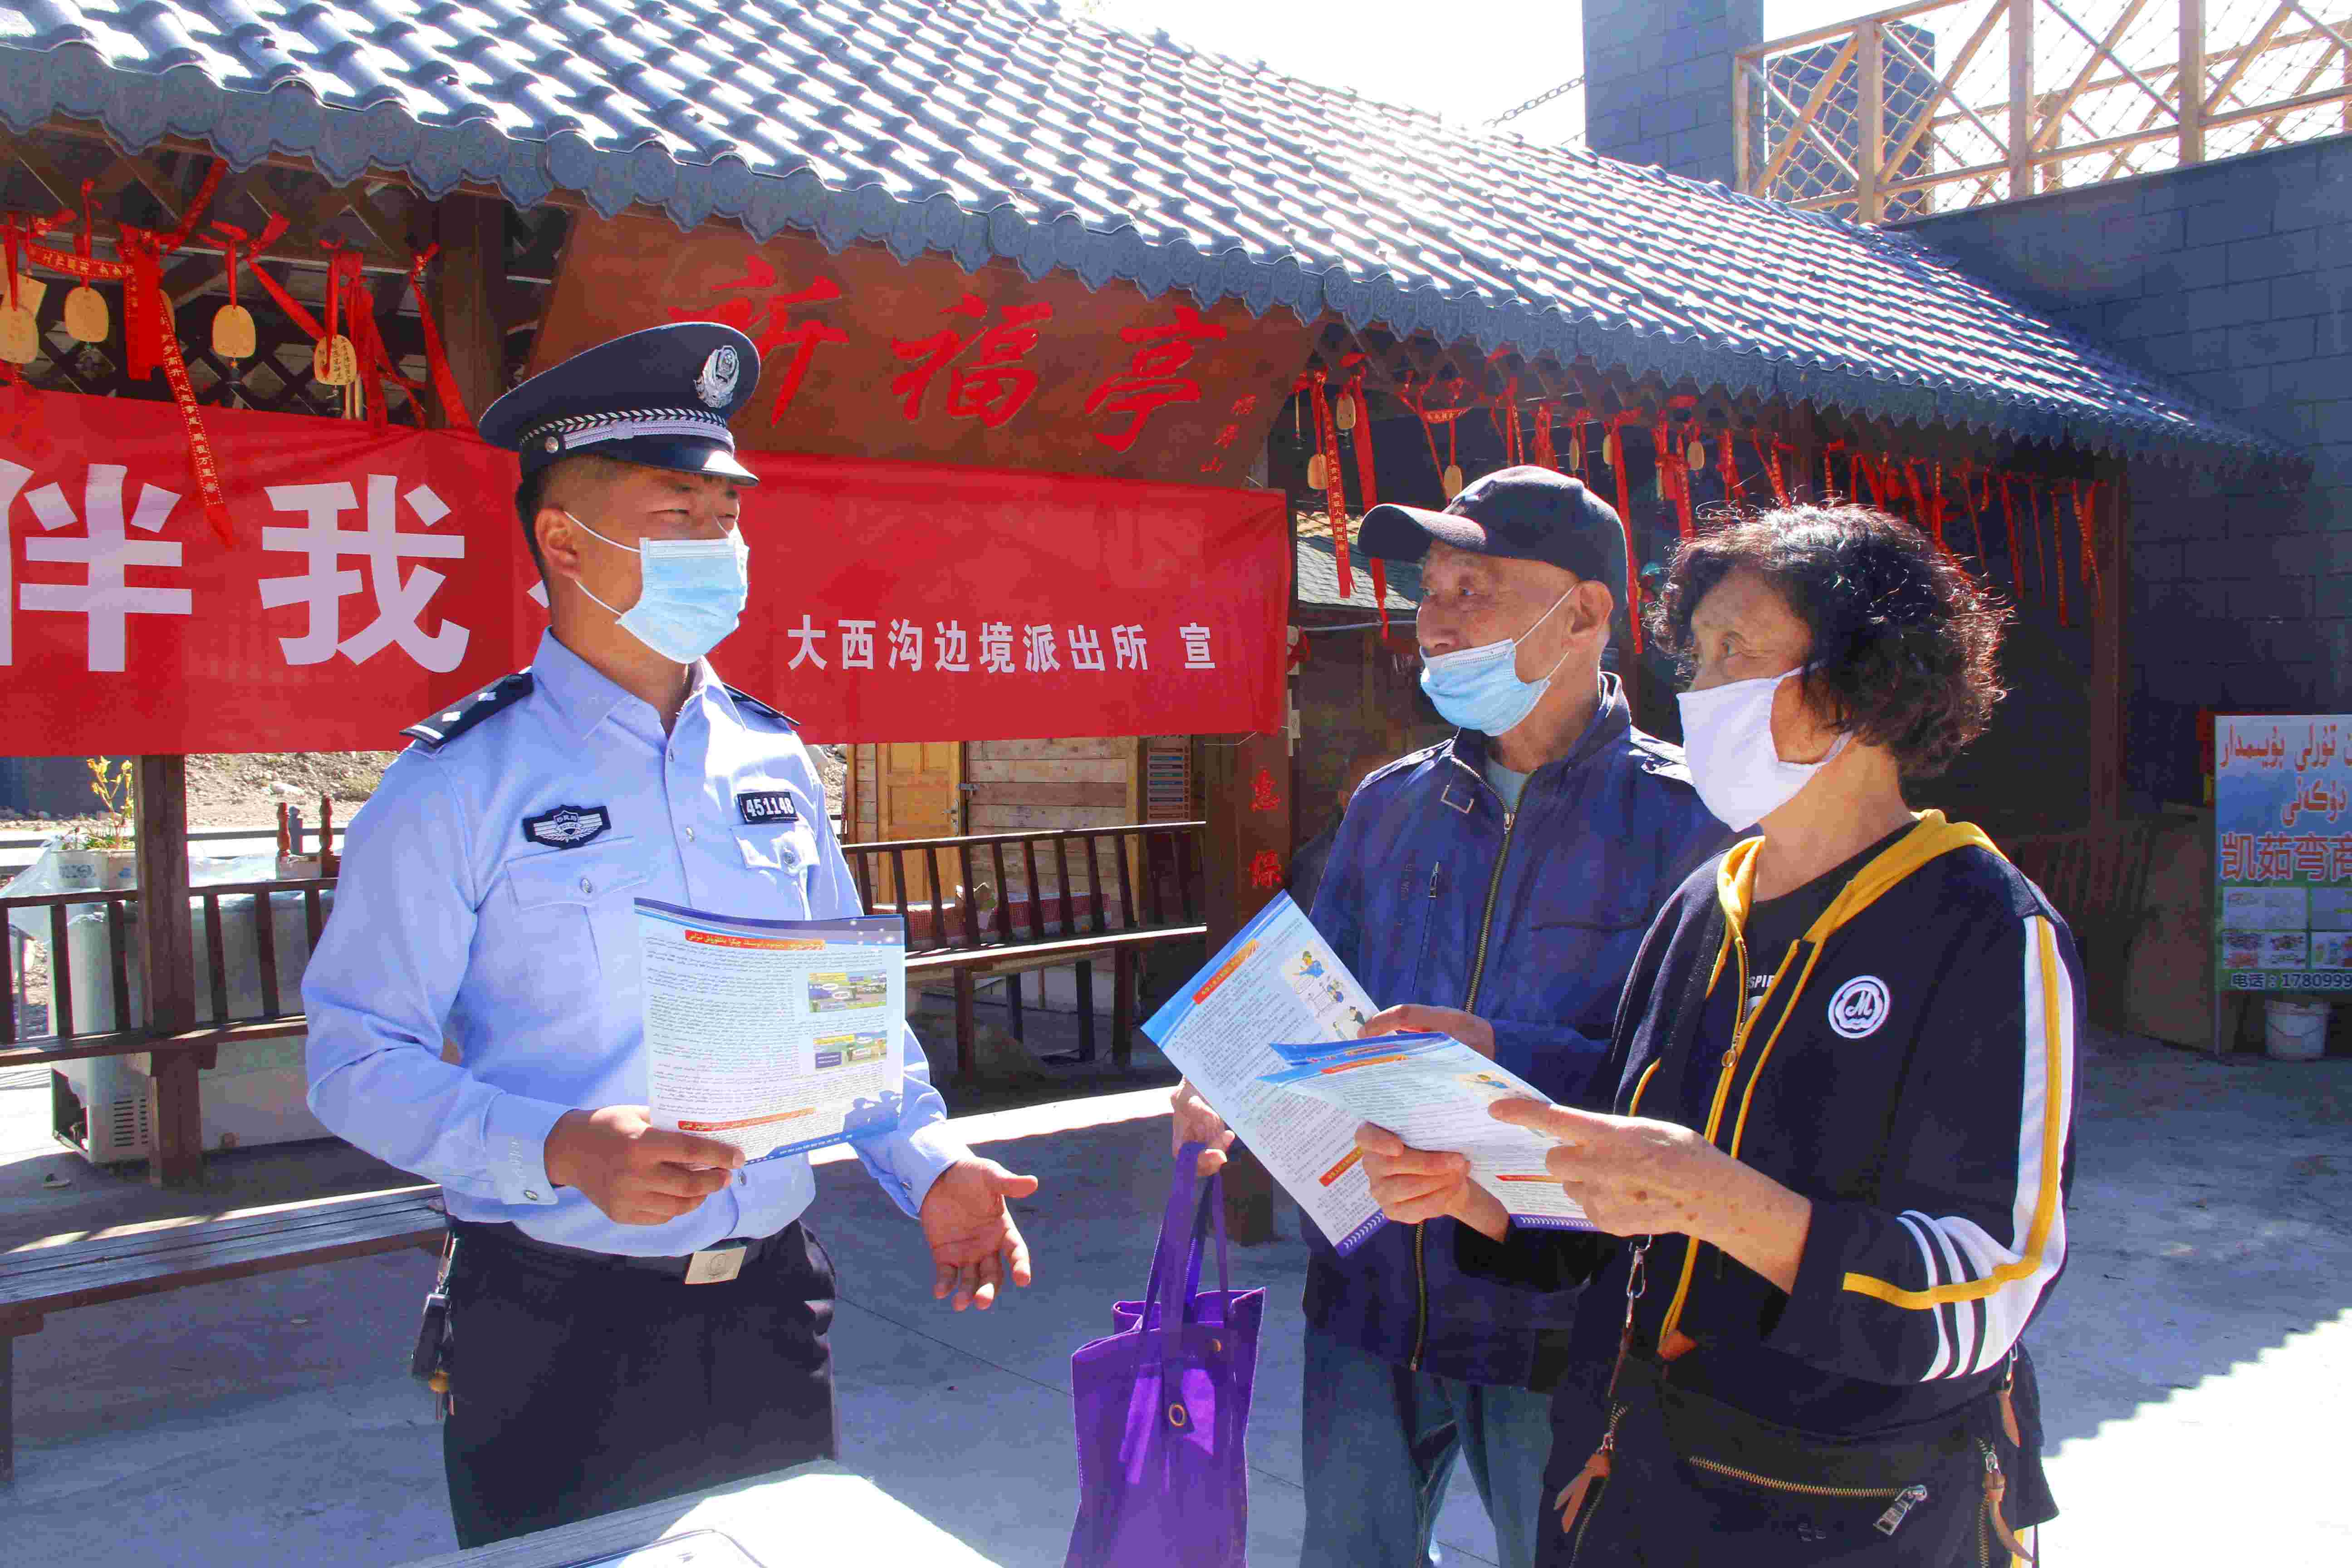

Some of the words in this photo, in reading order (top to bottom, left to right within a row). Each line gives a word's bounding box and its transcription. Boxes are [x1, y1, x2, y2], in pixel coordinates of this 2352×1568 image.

[0, 458, 550, 674] 伴我
[788, 615, 1147, 673] 大西沟边境派出所
[1180, 623, 1215, 668] 宣
[746, 796, 794, 817] 451148
